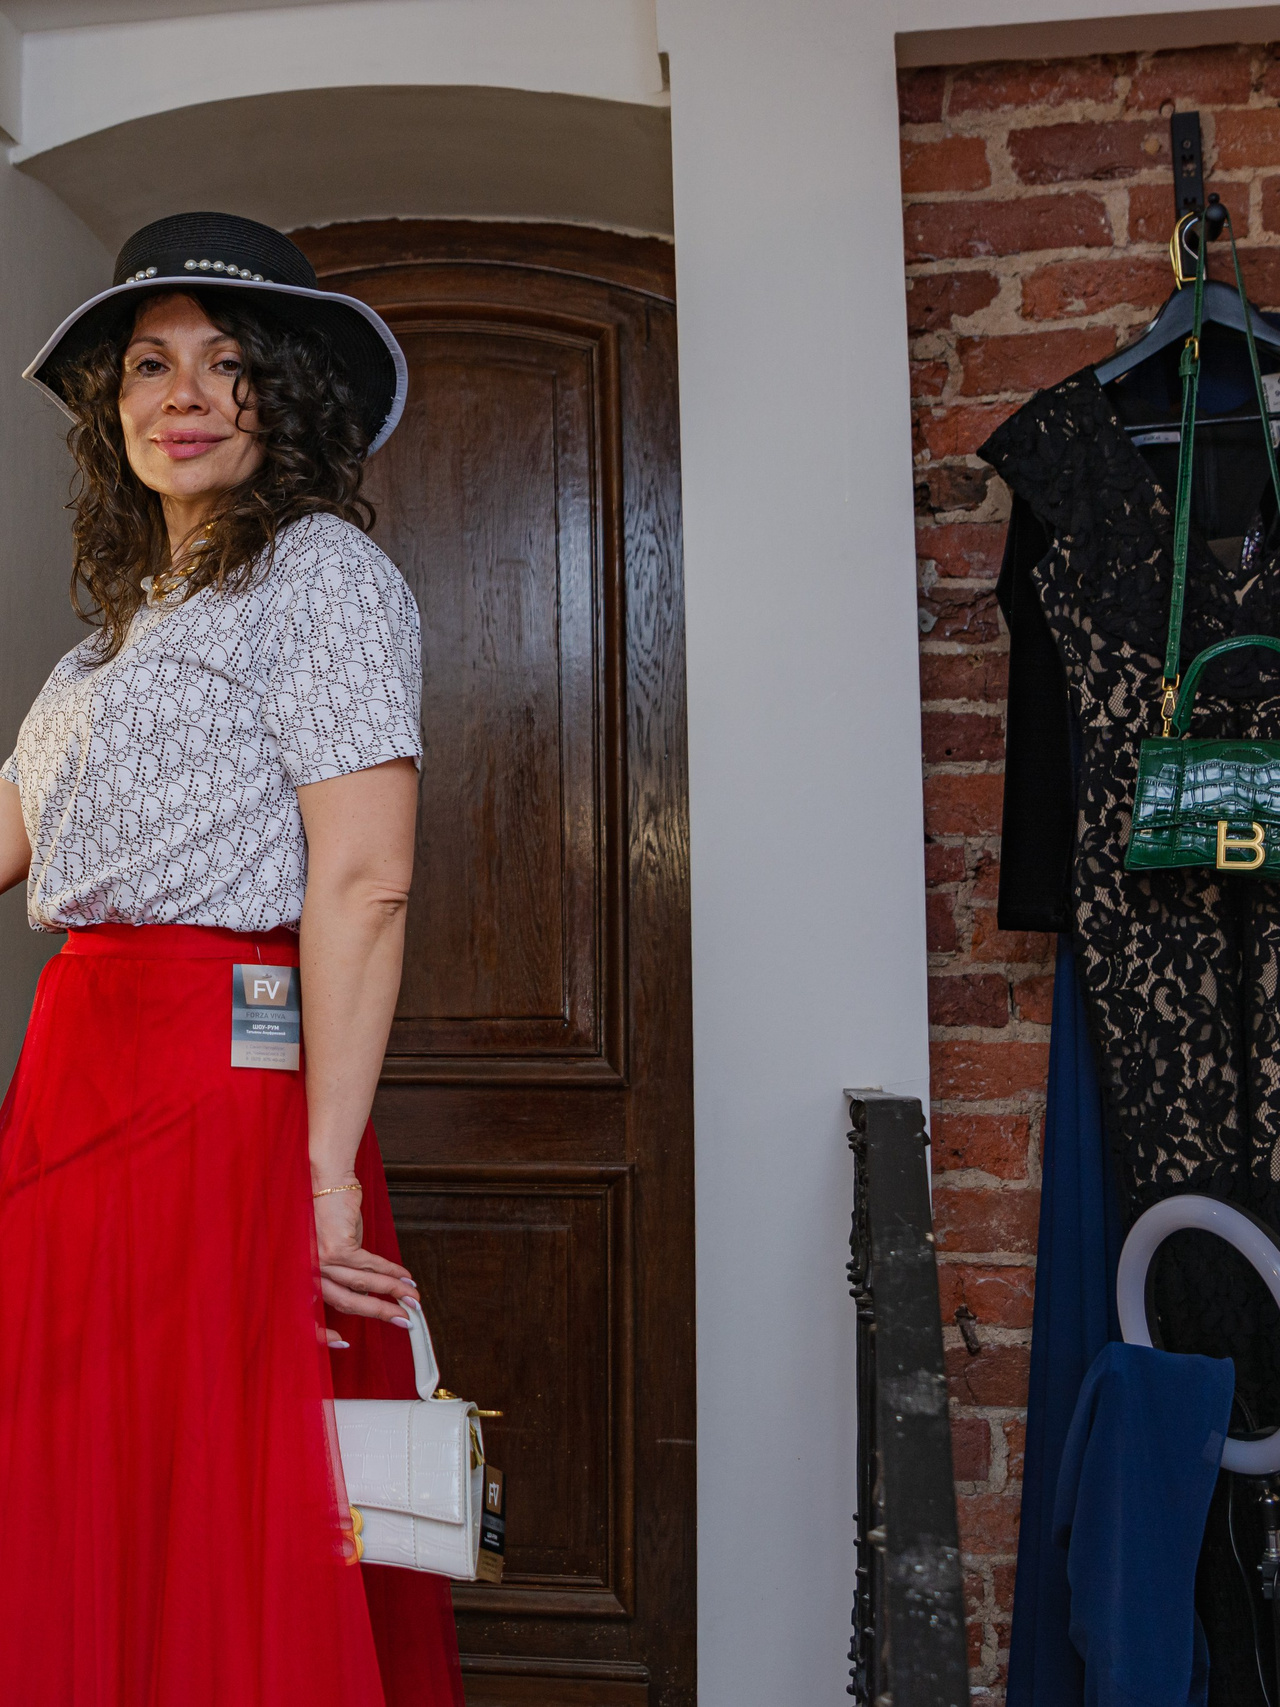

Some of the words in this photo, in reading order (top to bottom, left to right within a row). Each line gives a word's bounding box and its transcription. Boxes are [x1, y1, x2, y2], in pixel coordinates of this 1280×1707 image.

[1216, 820, 1266, 870] B
[253, 979, 280, 1000] FV
[246, 1011, 269, 1019] FORZA
[270, 1012, 286, 1020] VIVA
[252, 1023, 280, 1031] ШОУ-РУМ
